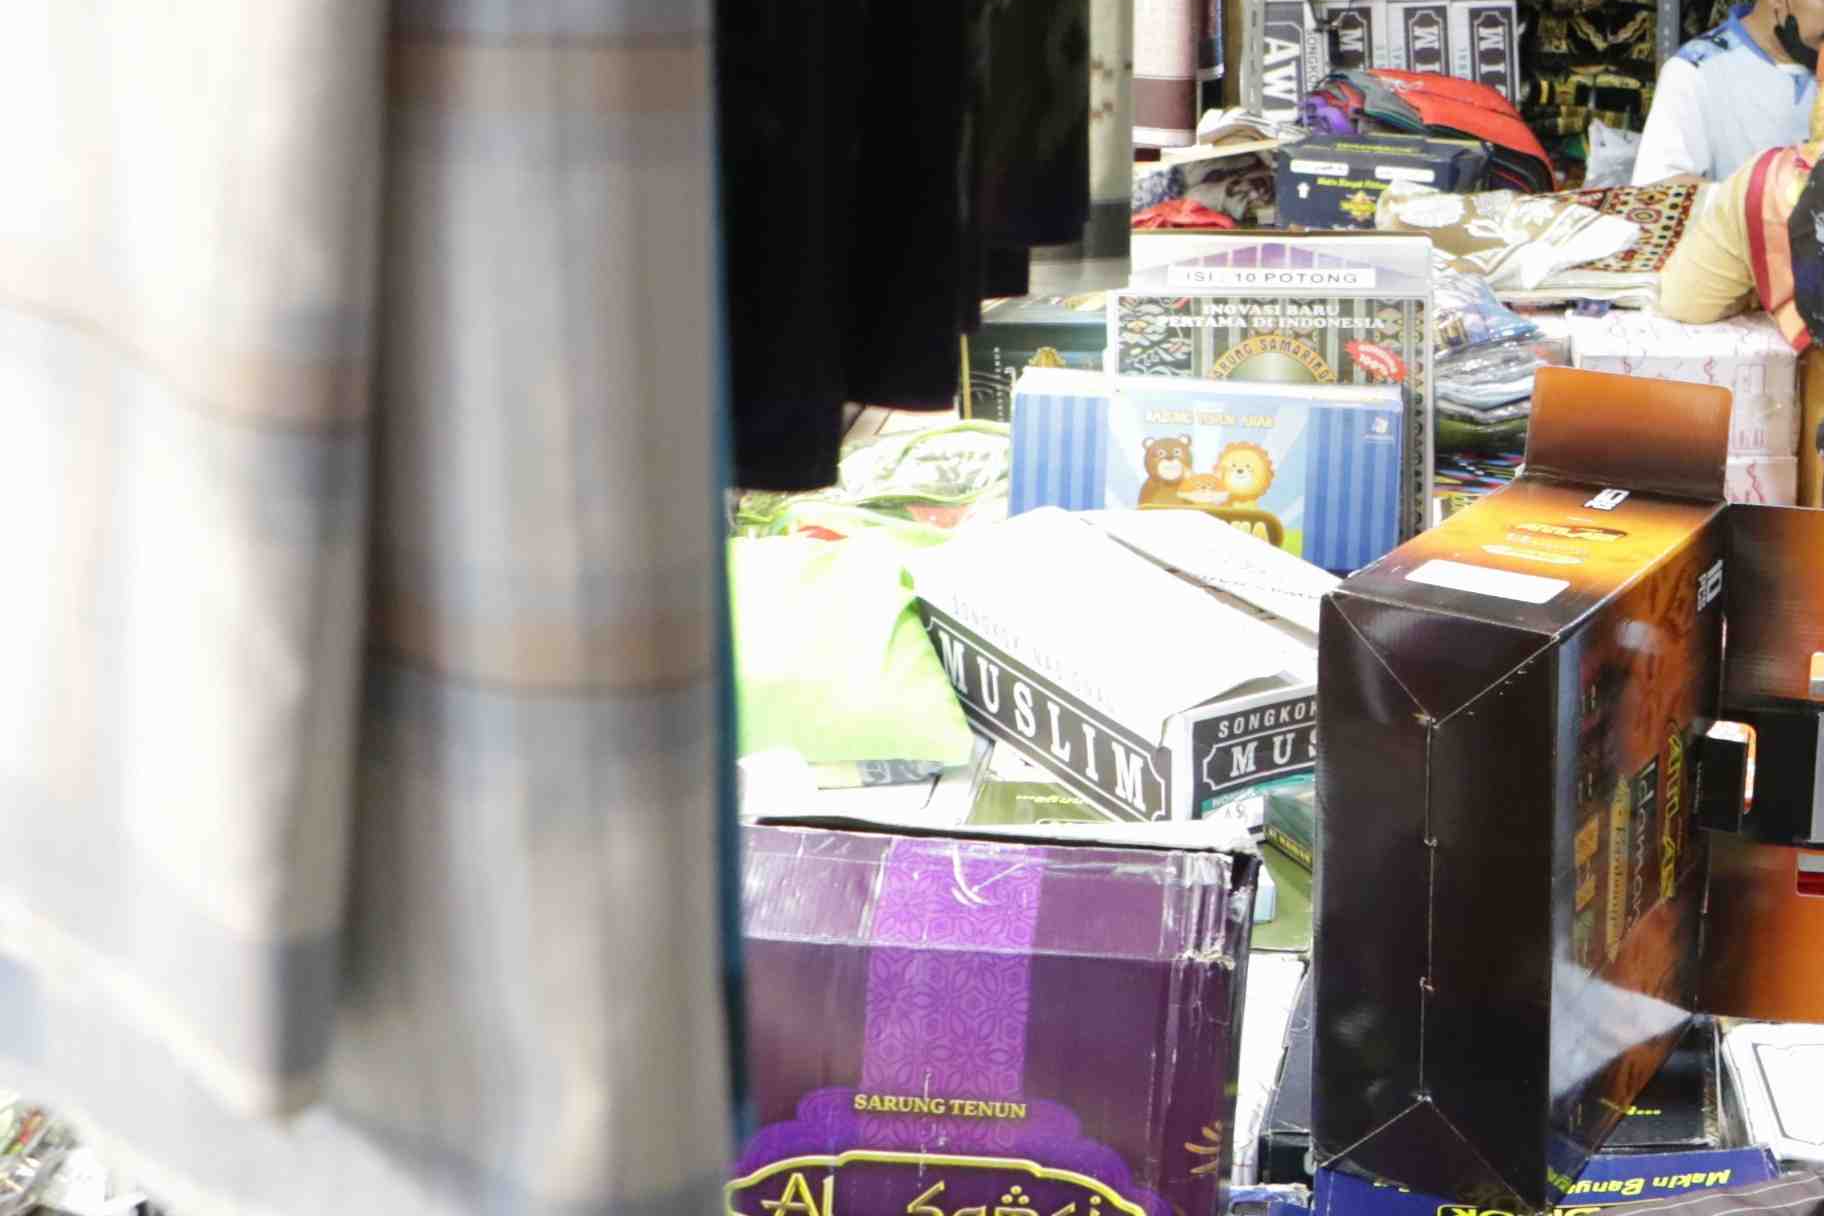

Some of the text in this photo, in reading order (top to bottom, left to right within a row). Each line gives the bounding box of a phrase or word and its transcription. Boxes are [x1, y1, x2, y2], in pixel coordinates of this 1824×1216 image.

[1264, 273, 1358, 284] POTONG
[939, 629, 1147, 812] MUSLIM
[853, 1093, 1027, 1119] SARUNG TENUN
[1652, 1168, 1732, 1190] Makin
